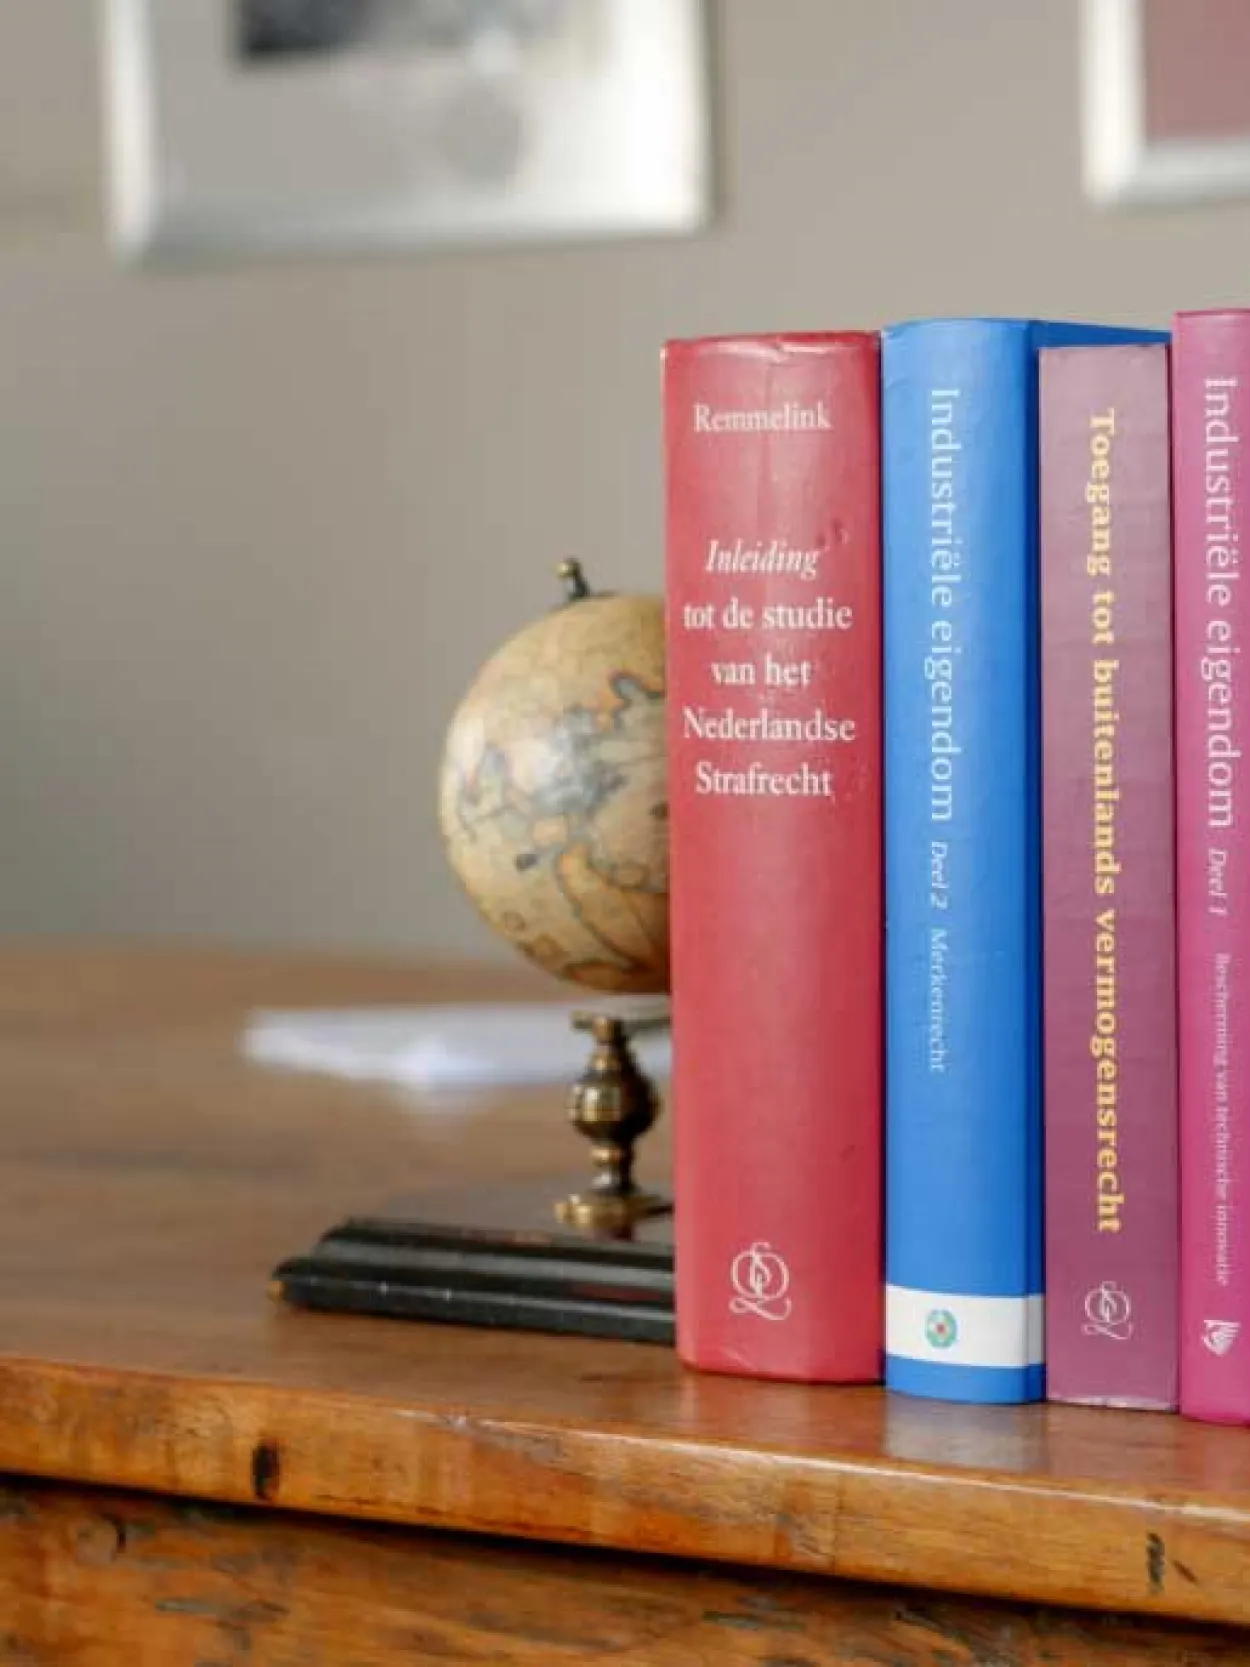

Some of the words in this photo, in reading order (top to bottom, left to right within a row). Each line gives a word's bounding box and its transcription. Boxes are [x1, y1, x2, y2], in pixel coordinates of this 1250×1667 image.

[693, 402, 832, 432] Remmelink
[930, 387, 963, 608] Industriële
[1087, 407, 1116, 577] Toegang
[1205, 377, 1239, 608] Industriële
[706, 539, 820, 580] Inleiding
[684, 602, 716, 630] tot
[723, 597, 753, 630] de
[762, 598, 853, 631] studie
[1092, 592, 1115, 644] tot
[711, 663, 755, 686] van
[765, 653, 812, 687] het
[683, 706, 856, 742] Nederlandse
[924, 620, 962, 822] eigendom
[1201, 620, 1241, 828] eigendom
[696, 761, 835, 798] Strafrecht
[1093, 660, 1121, 896] buitenlands
[930, 841, 949, 889] Deel
[1208, 848, 1228, 897] Deel
[929, 892, 948, 909] 2
[927, 928, 950, 1073] Merkenrecht
[1090, 909, 1124, 1234] vermogensrecht
